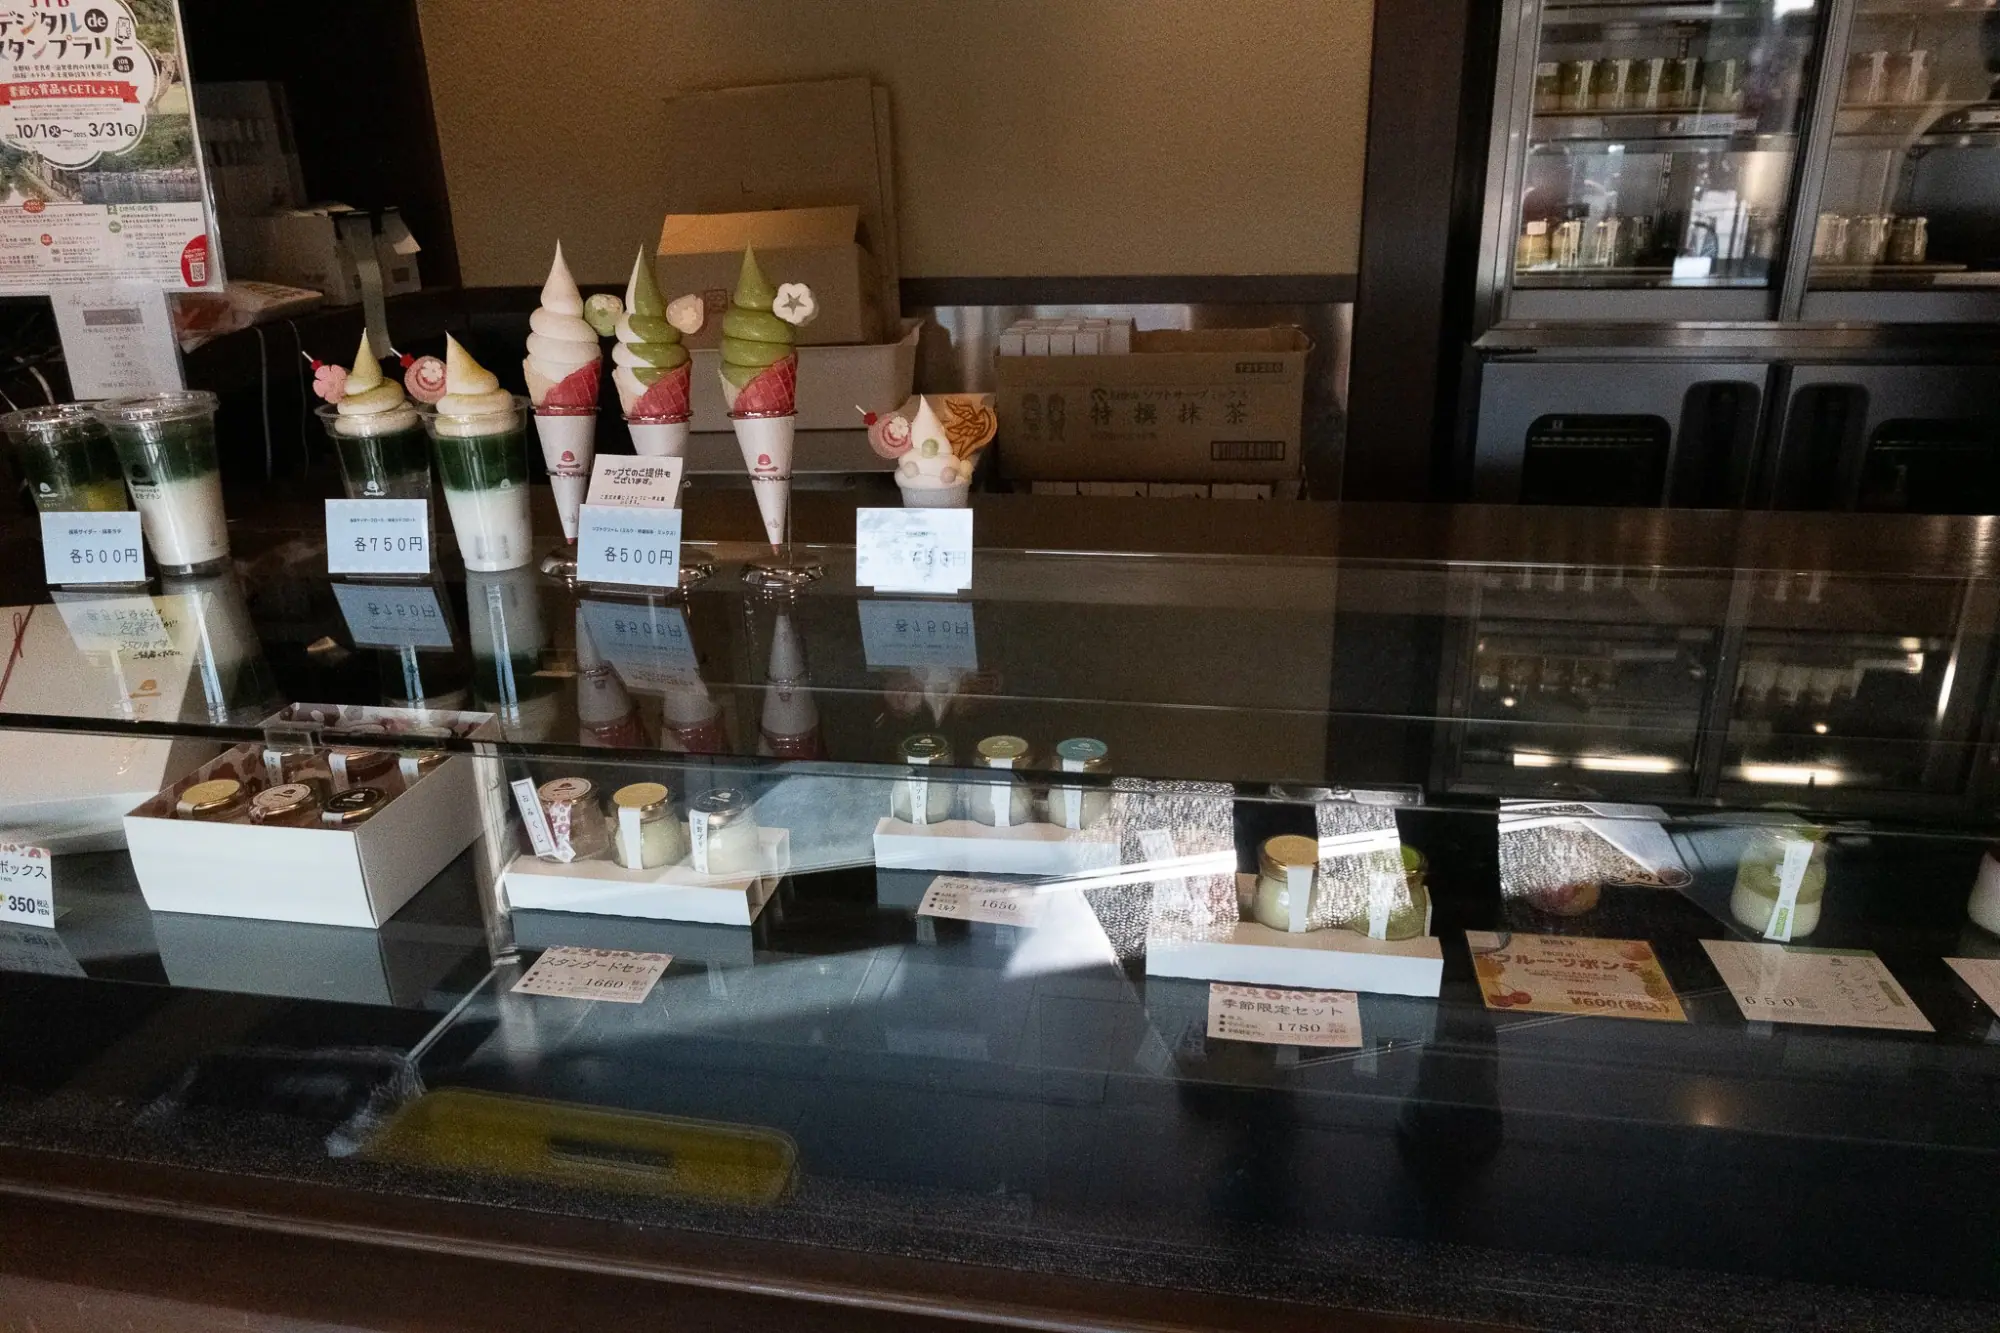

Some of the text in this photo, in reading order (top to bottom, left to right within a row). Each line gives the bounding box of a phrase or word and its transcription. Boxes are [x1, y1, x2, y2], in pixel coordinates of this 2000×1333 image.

[87, 13, 106, 28] de
[16, 124, 48, 138] 10/1
[88, 122, 124, 137] 3/31
[354, 536, 423, 552] 各750円
[69, 548, 138, 564] 各500円
[604, 546, 673, 566] 各500円
[8, 895, 35, 913] 350
[980, 899, 1017, 911] 1650
[541, 956, 658, 974] スタンダードセット
[585, 977, 624, 989] 1660
[1222, 999, 1344, 1016] 季節限定セット
[1277, 1022, 1321, 1033] 1780
